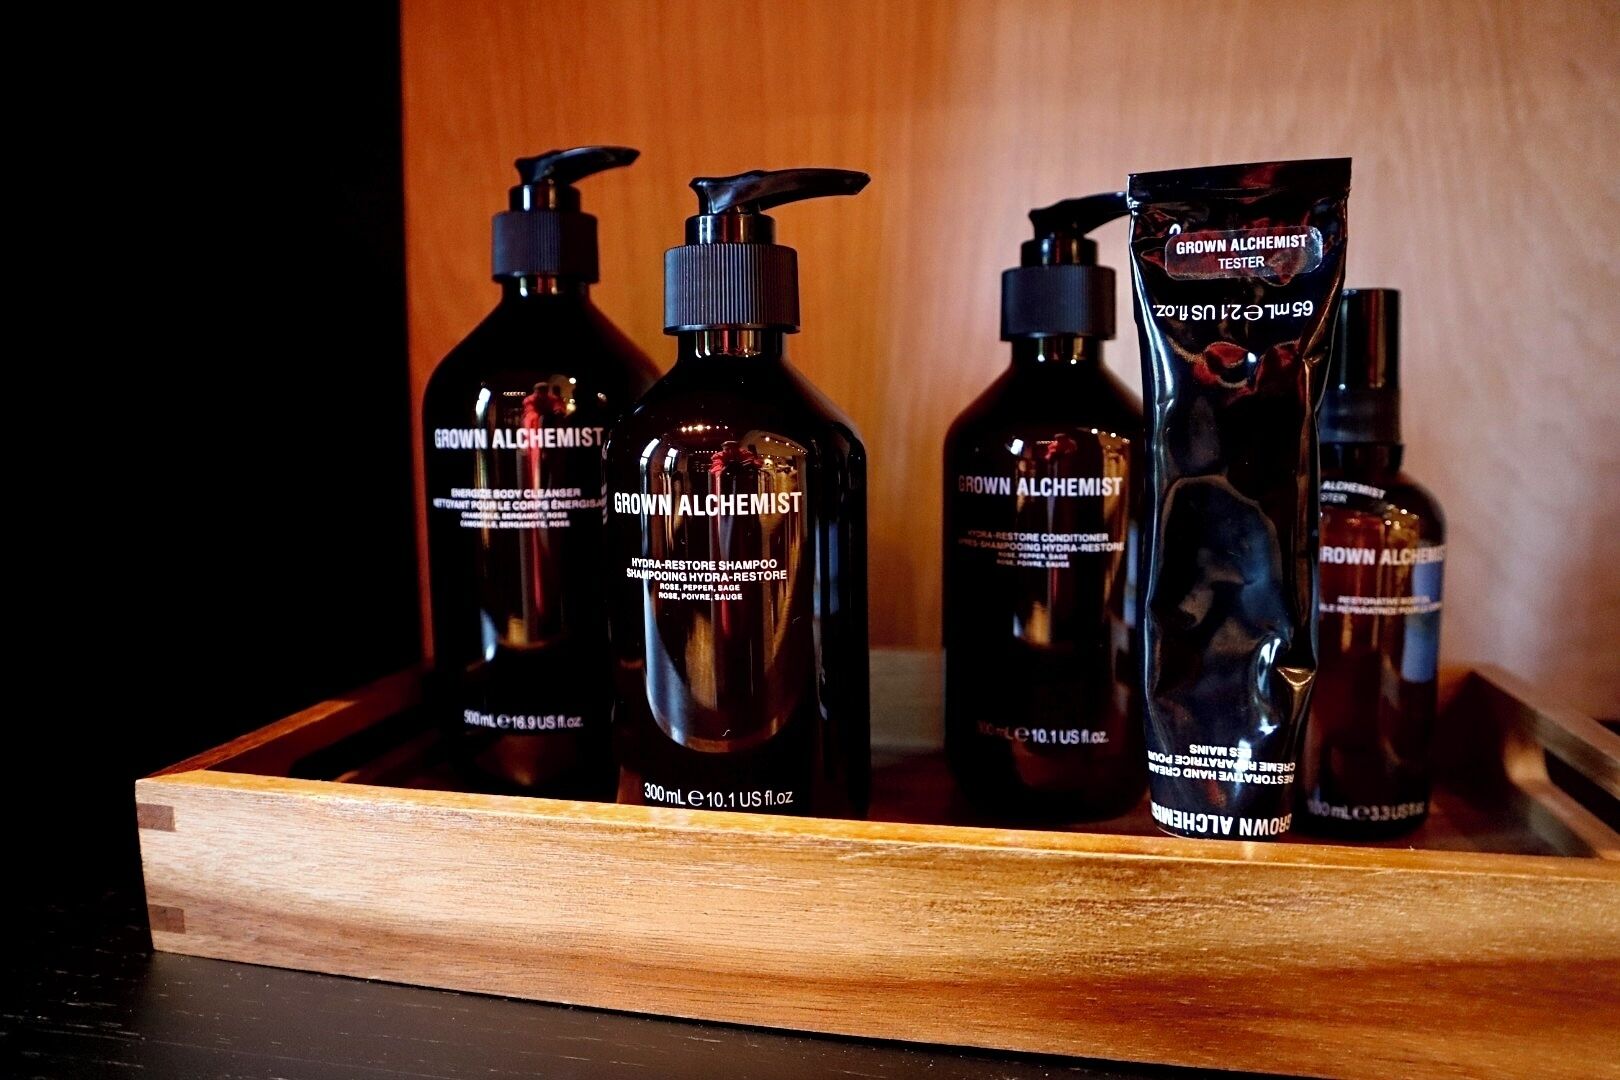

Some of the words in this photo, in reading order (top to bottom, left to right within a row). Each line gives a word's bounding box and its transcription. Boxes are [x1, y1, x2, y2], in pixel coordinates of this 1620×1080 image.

[1176, 239, 1227, 255] GROWN
[1230, 234, 1307, 252] ALCHEMIST
[1218, 256, 1265, 269] TESTER
[1192, 304, 1215, 320] US
[1221, 304, 1241, 320] 2.1
[1293, 300, 1313, 317] 65
[434, 428, 488, 449] GROWN
[492, 427, 604, 449] ALCHEMIST
[958, 475, 1011, 496] GROWN
[1016, 477, 1123, 497] ALCHEMIST
[1322, 481, 1386, 500] ALCHEMIST
[493, 488, 521, 499] BODY
[523, 488, 581, 499] CLEANSER
[1320, 492, 1347, 504] STER
[471, 500, 497, 510] POUR
[497, 500, 511, 511] LE
[512, 500, 549, 511] CORPS
[614, 492, 671, 516] GROWN
[678, 492, 802, 516] ALCHEMIST
[547, 511, 567, 520] ROSE
[549, 520, 570, 528] ROSE
[1041, 532, 1109, 543] CONDITIONER
[1042, 541, 1125, 552] HYDRA-RESTORE
[1048, 553, 1068, 561] SAGE
[632, 558, 716, 571] HYDRA-RESTORE
[718, 559, 777, 571] SHAMPOO
[626, 568, 687, 582] SHAMPOOING
[689, 570, 787, 582] HYDRA-RESTORE
[660, 583, 682, 592] ROSE,
[683, 584, 716, 592] PEPPER,
[718, 584, 740, 592] SAGE
[659, 592, 680, 600] ROSE,
[682, 593, 713, 601] POIVRE,
[511, 715, 535, 730] 16.9
[537, 715, 556, 730] US
[1031, 727, 1057, 744] 10.1
[1059, 729, 1080, 744] US
[1189, 744, 1227, 757] MAINS
[1183, 767, 1216, 780] HAND
[1260, 761, 1295, 774] CRÈME
[1219, 770, 1294, 785] RESTORATIVE
[644, 782, 664, 801] 300
[666, 789, 686, 805] mL
[706, 791, 735, 808] 10.1
[740, 791, 762, 808] US
[1151, 801, 1234, 835] ALCHEMIS
[1239, 813, 1292, 836] GROWN
